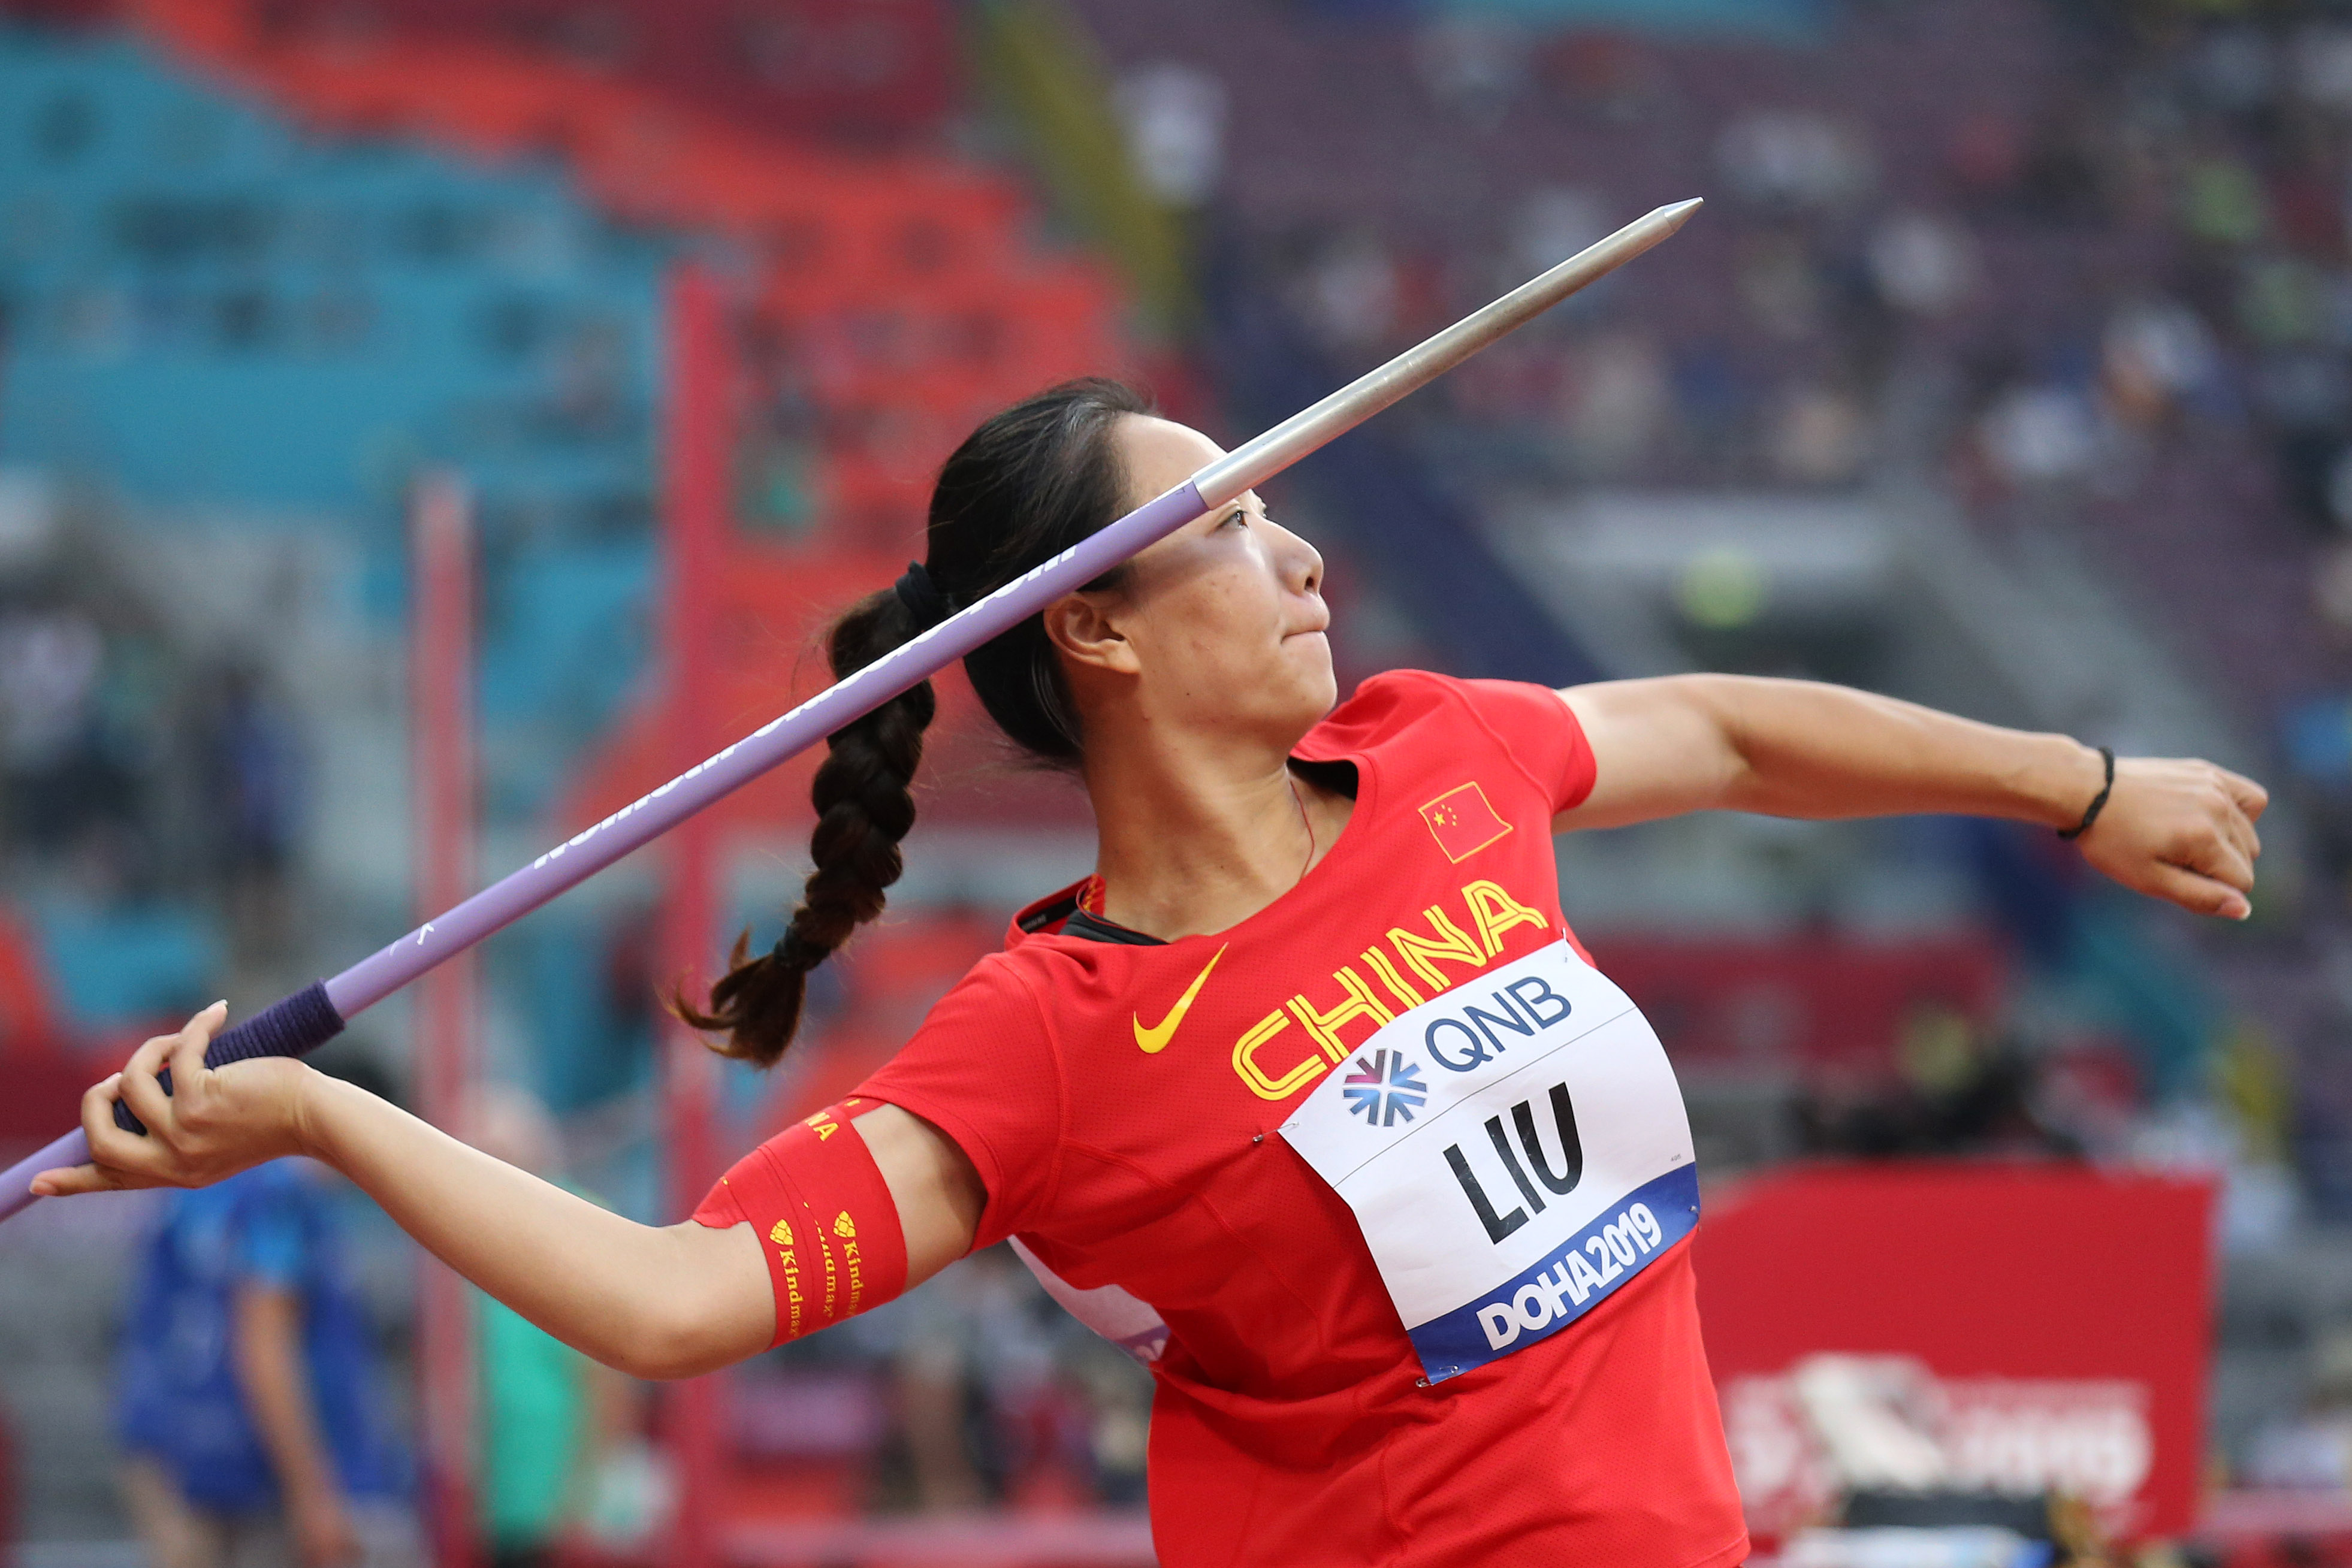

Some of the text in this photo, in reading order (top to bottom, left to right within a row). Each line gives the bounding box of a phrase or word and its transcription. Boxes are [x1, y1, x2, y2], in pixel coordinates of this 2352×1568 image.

[1232, 880, 1549, 1101] CHINA
[1425, 976, 1572, 1072] QNB
[1442, 1081, 1583, 1245] LIU
